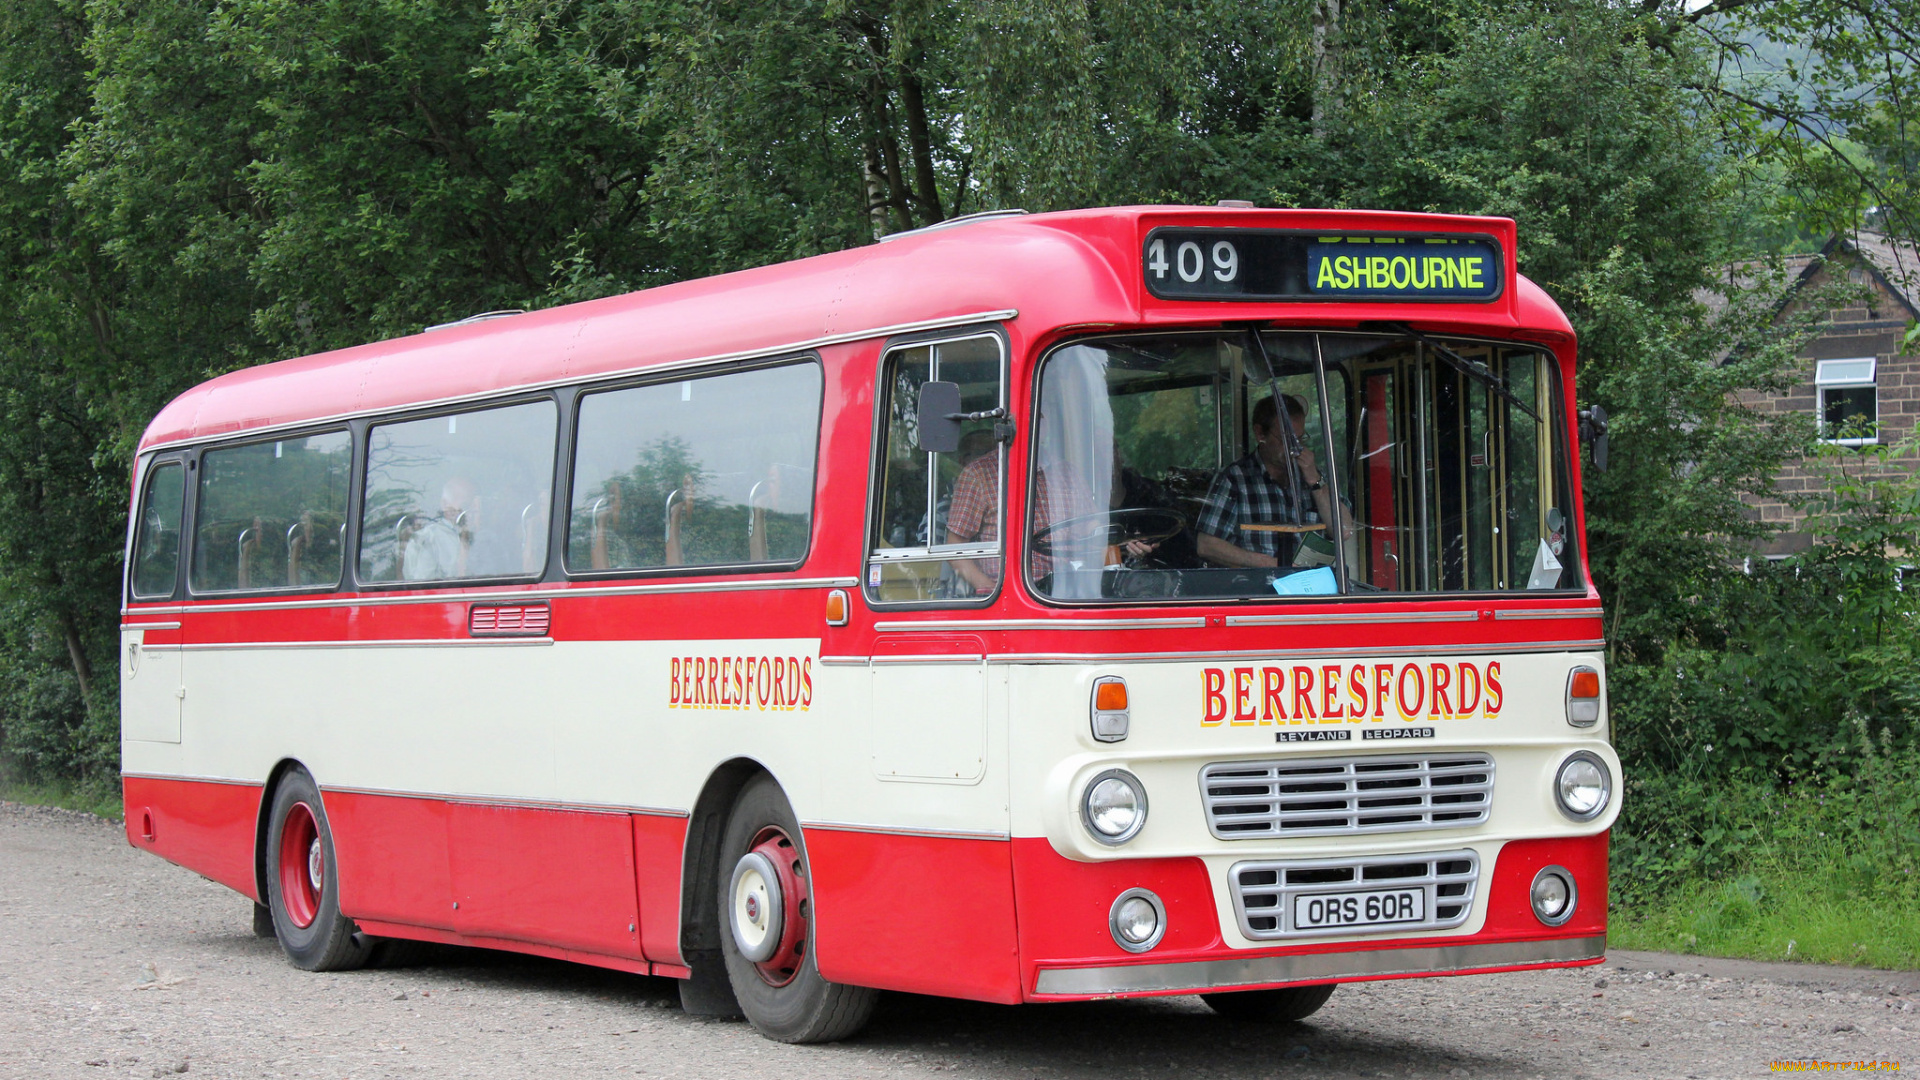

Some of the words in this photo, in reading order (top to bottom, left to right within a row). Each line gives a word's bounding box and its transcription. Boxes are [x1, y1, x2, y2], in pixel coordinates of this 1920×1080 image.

[1149, 239, 1239, 282] 409
[1316, 255, 1484, 290] ASHBOURNE
[669, 656, 812, 711] BERRESFORDS
[1200, 661, 1504, 727] BERRESFORDS
[1279, 730, 1348, 742] LEYLAND
[1365, 728, 1433, 739] LEOPARD
[1308, 896, 1358, 924] ORS
[1365, 894, 1414, 919] 60R
